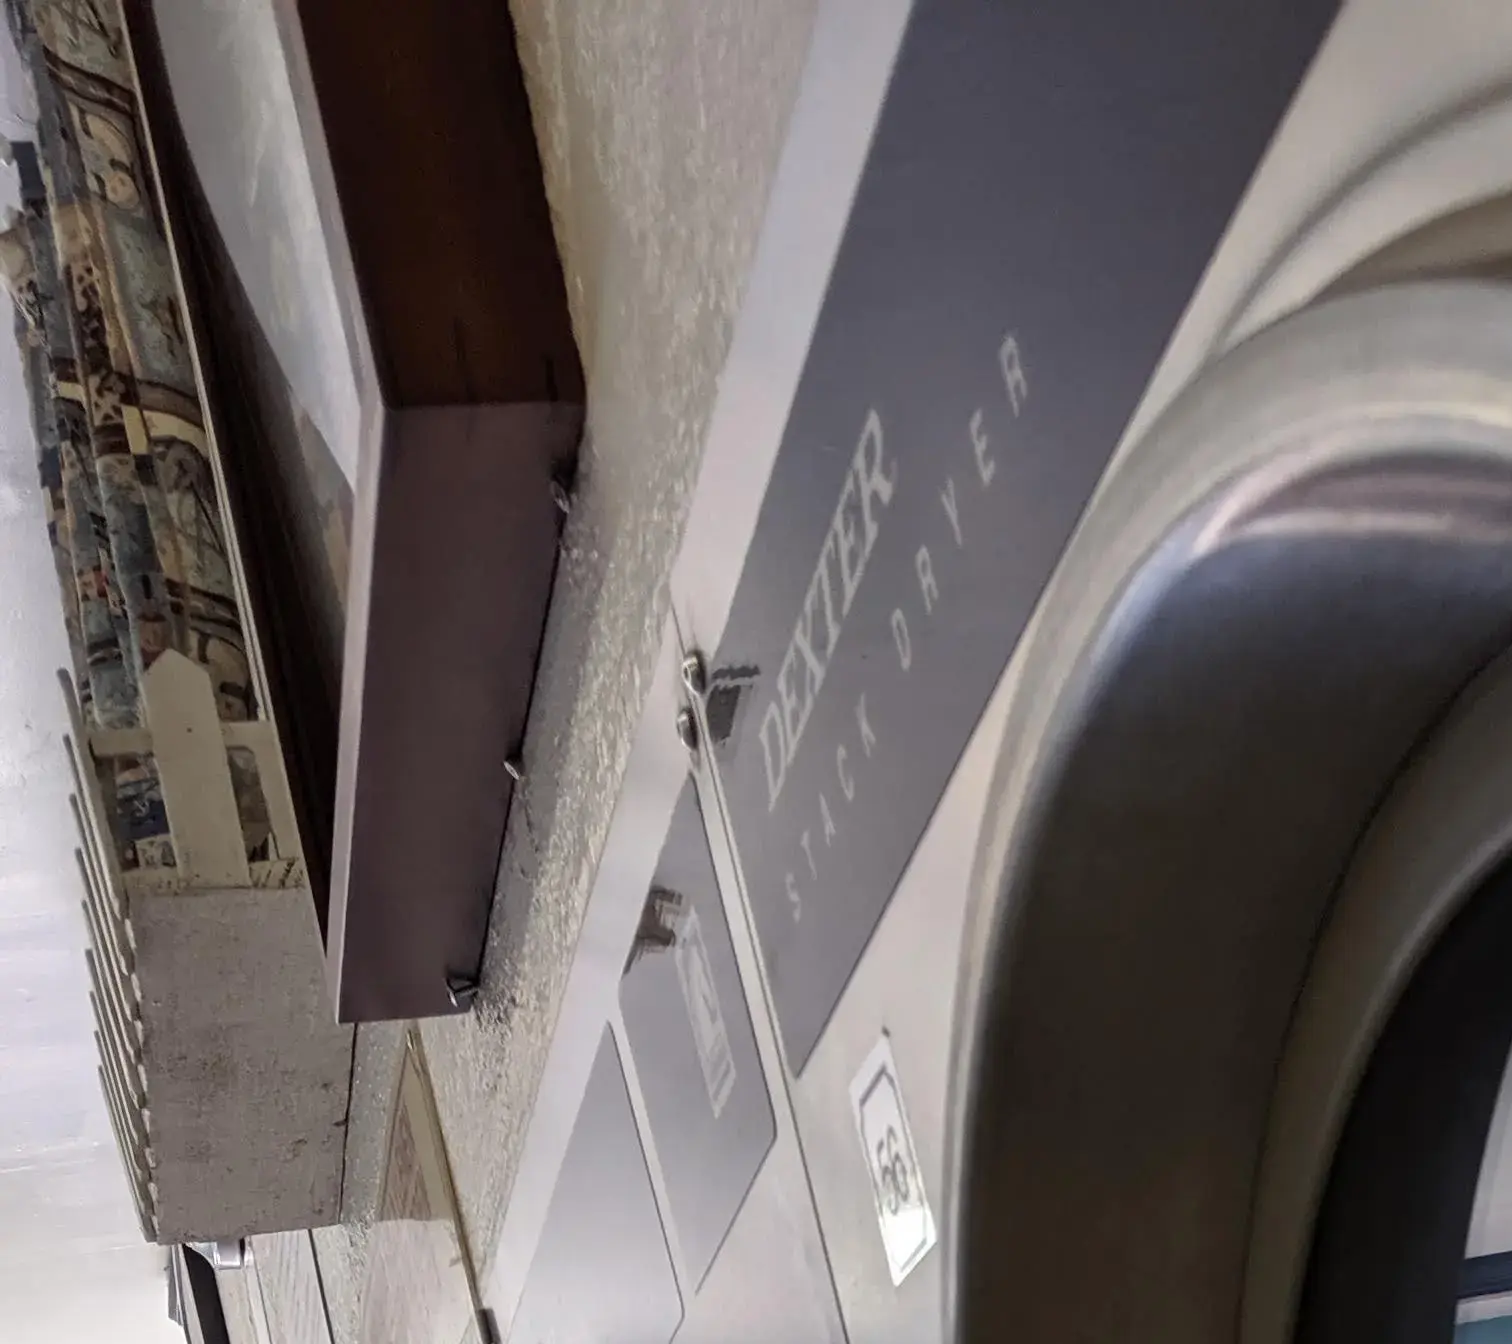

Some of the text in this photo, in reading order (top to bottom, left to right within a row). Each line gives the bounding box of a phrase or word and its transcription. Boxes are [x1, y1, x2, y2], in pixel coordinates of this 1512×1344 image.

[758, 407, 896, 812] DEXTER
[785, 329, 1028, 923] STACK DRYER
